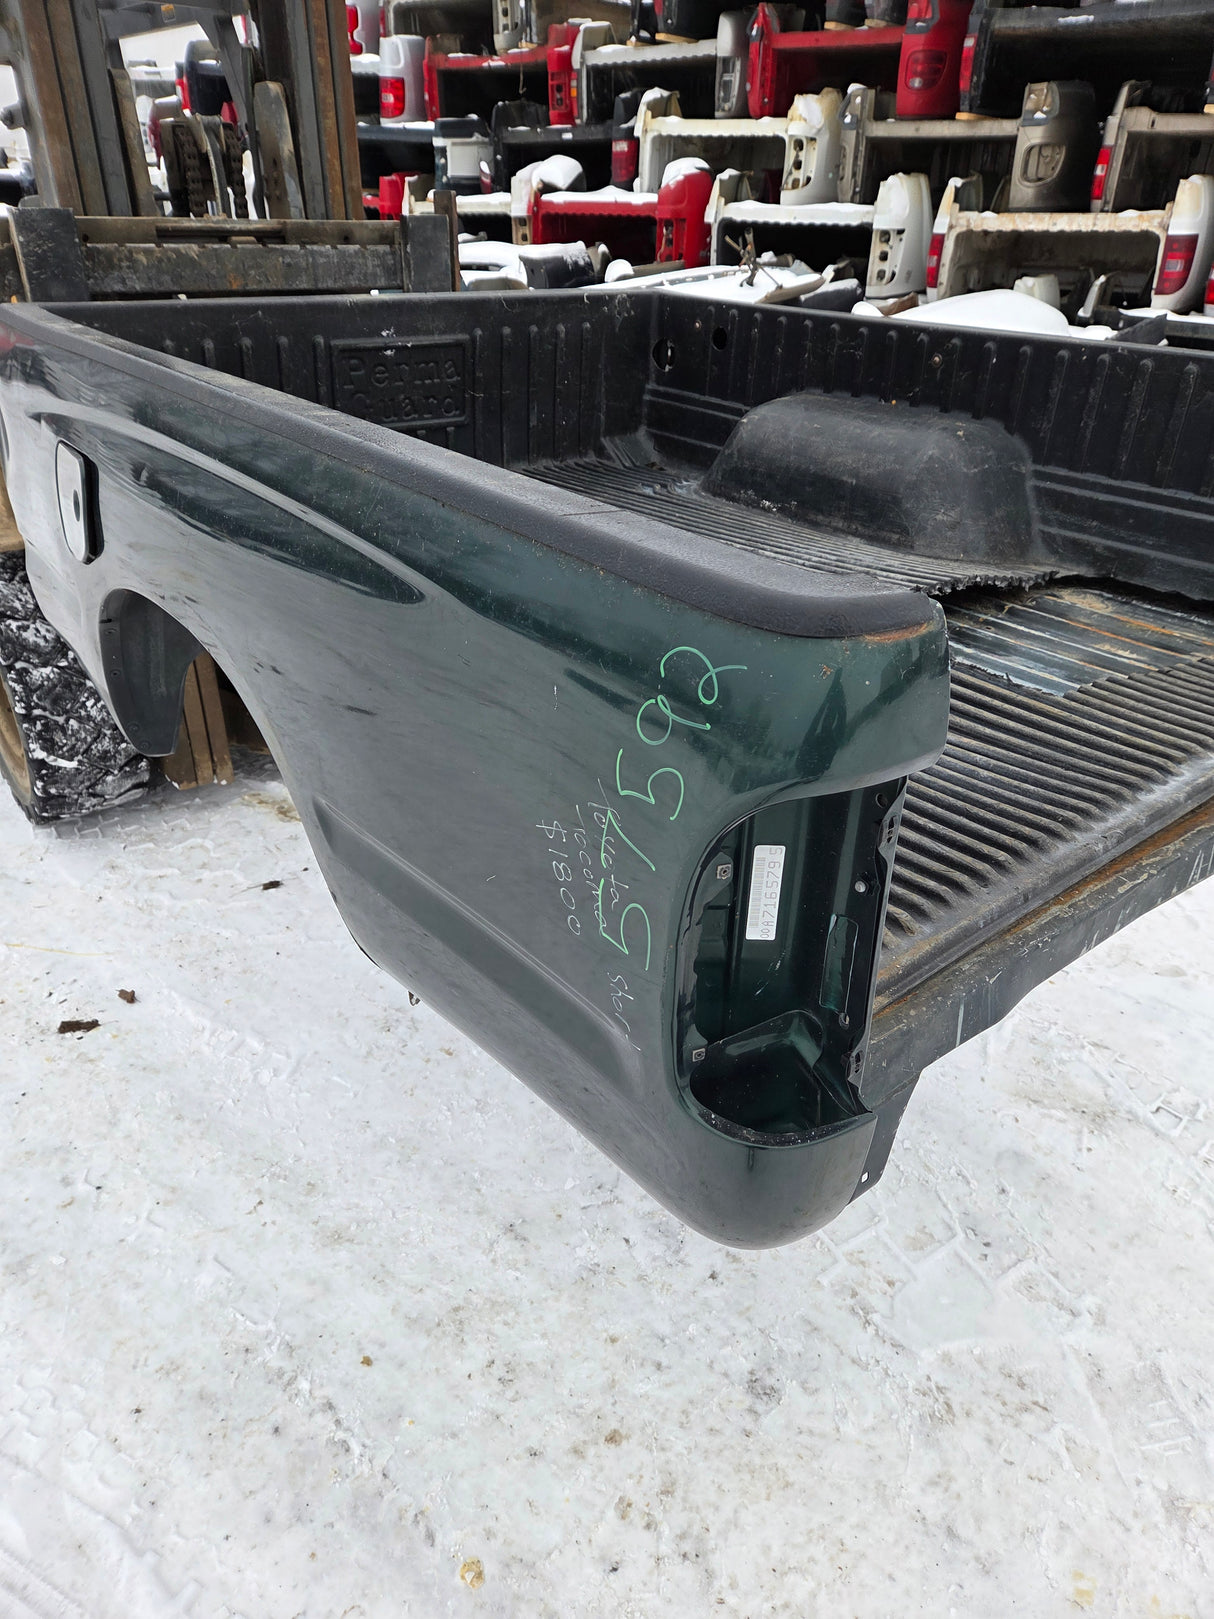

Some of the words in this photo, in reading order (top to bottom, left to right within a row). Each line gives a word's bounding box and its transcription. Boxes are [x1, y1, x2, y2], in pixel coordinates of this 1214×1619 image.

[342, 357, 461, 388] Perma
[599, 646, 748, 971] 57592
[536, 820, 581, 936] $1800
